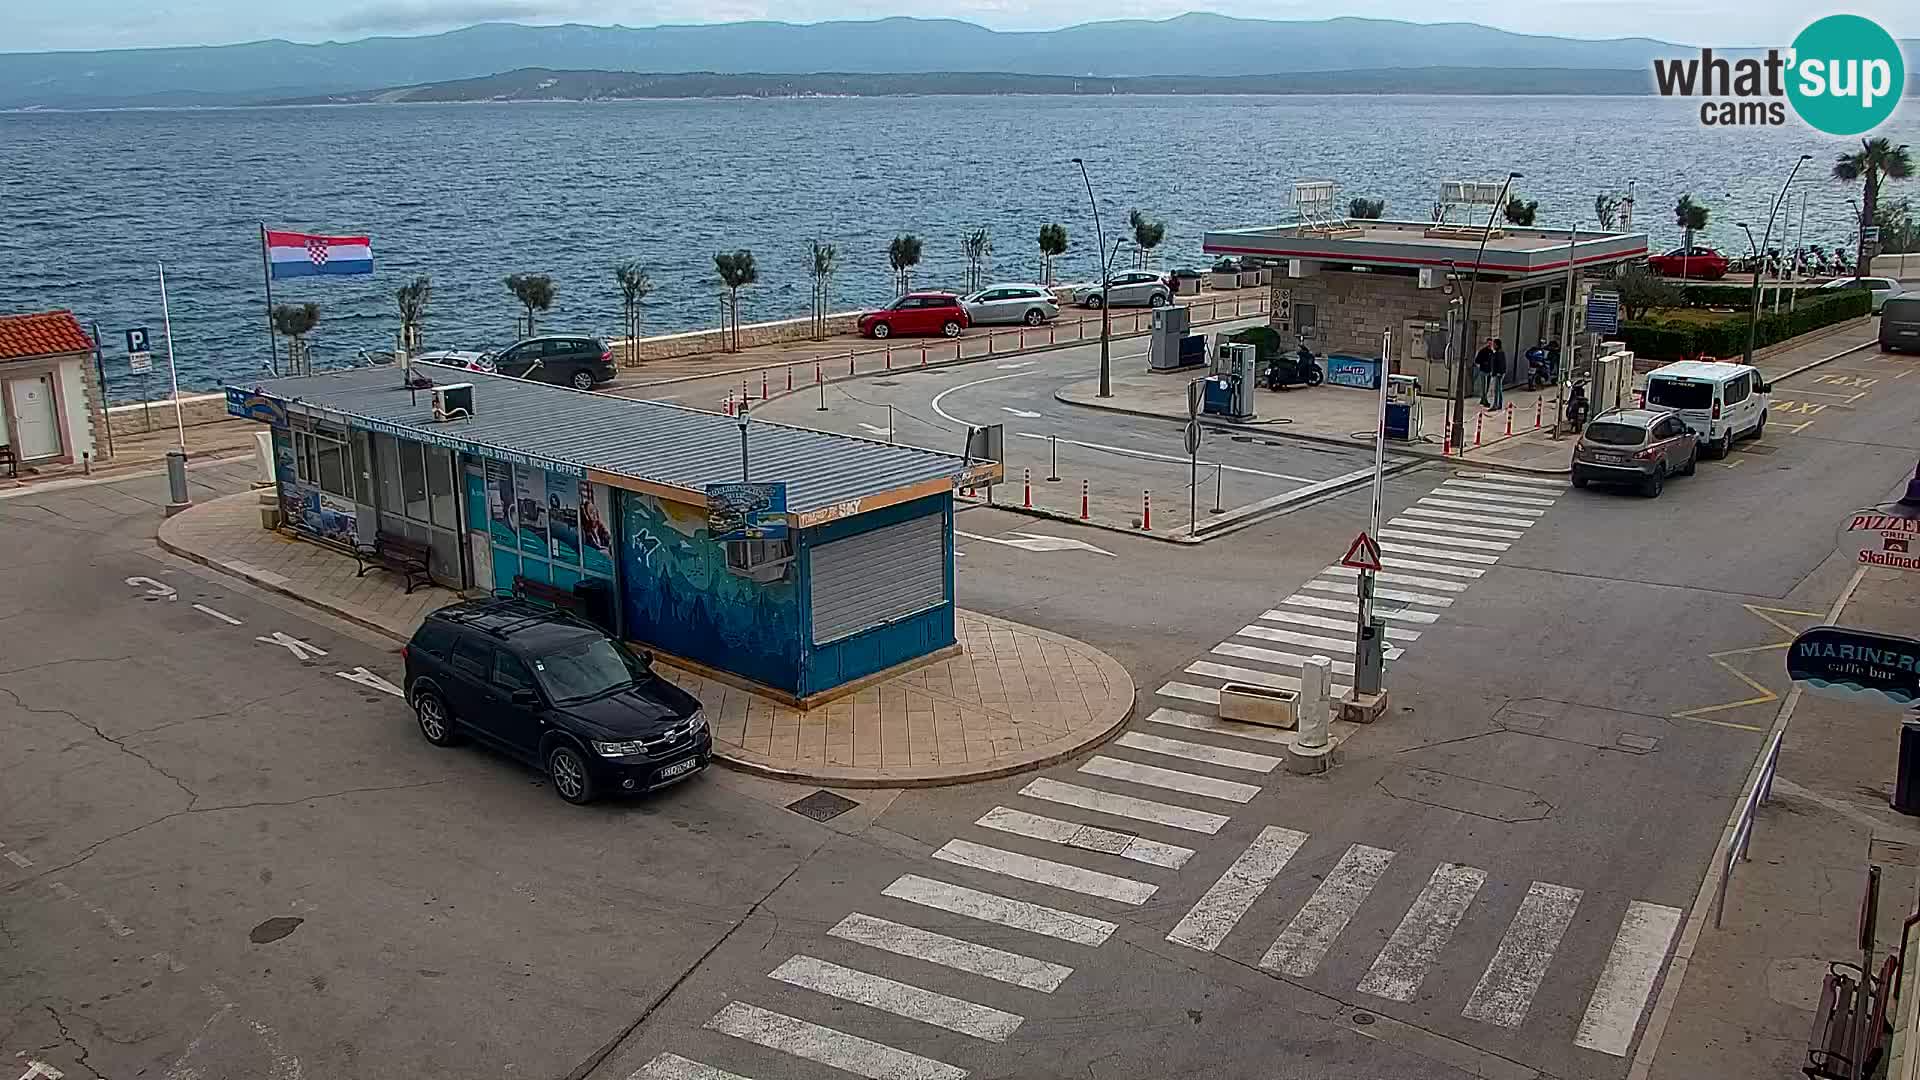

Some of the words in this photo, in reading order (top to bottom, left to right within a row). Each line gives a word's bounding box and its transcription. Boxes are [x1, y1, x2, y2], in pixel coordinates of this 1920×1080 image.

[130, 331, 144, 351] P
[1811, 374, 1880, 388] TAXI
[437, 436, 469, 452] POSTAJA
[479, 447, 494, 458] BUS
[494, 449, 527, 465] STATION
[528, 457, 554, 471] TICKET
[555, 462, 583, 477] OFFICE
[1847, 515, 1920, 533] PIZZE
[1880, 530, 1916, 541] GRILL
[1828, 663, 1864, 676] caffe
[1869, 666, 1896, 680] bar
